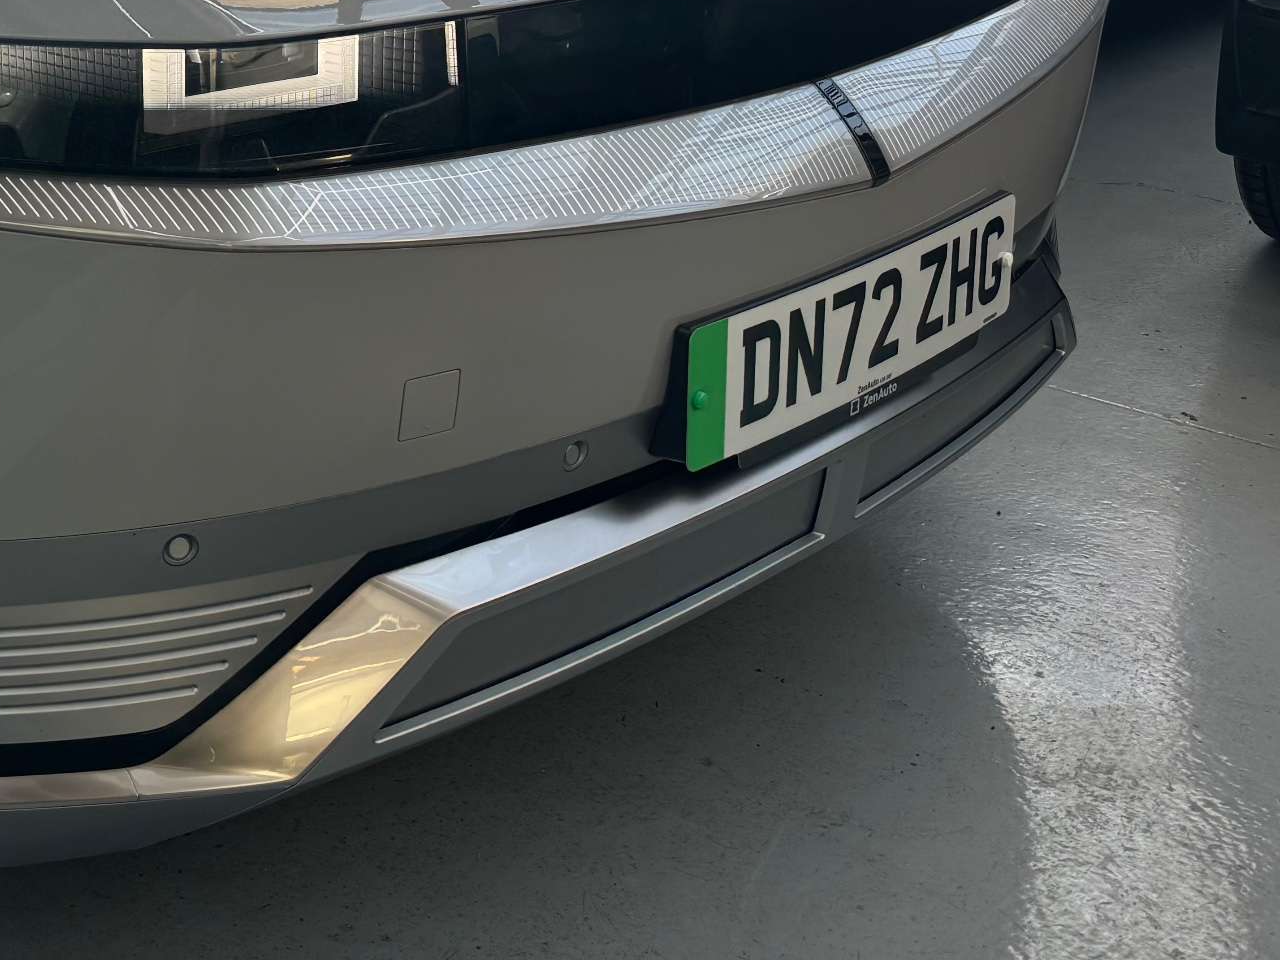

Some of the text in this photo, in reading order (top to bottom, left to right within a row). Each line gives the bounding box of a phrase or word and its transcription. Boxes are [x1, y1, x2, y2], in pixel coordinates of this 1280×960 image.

[740, 215, 1005, 428] DN72 ZHG
[863, 382, 898, 408] ZenAuto
